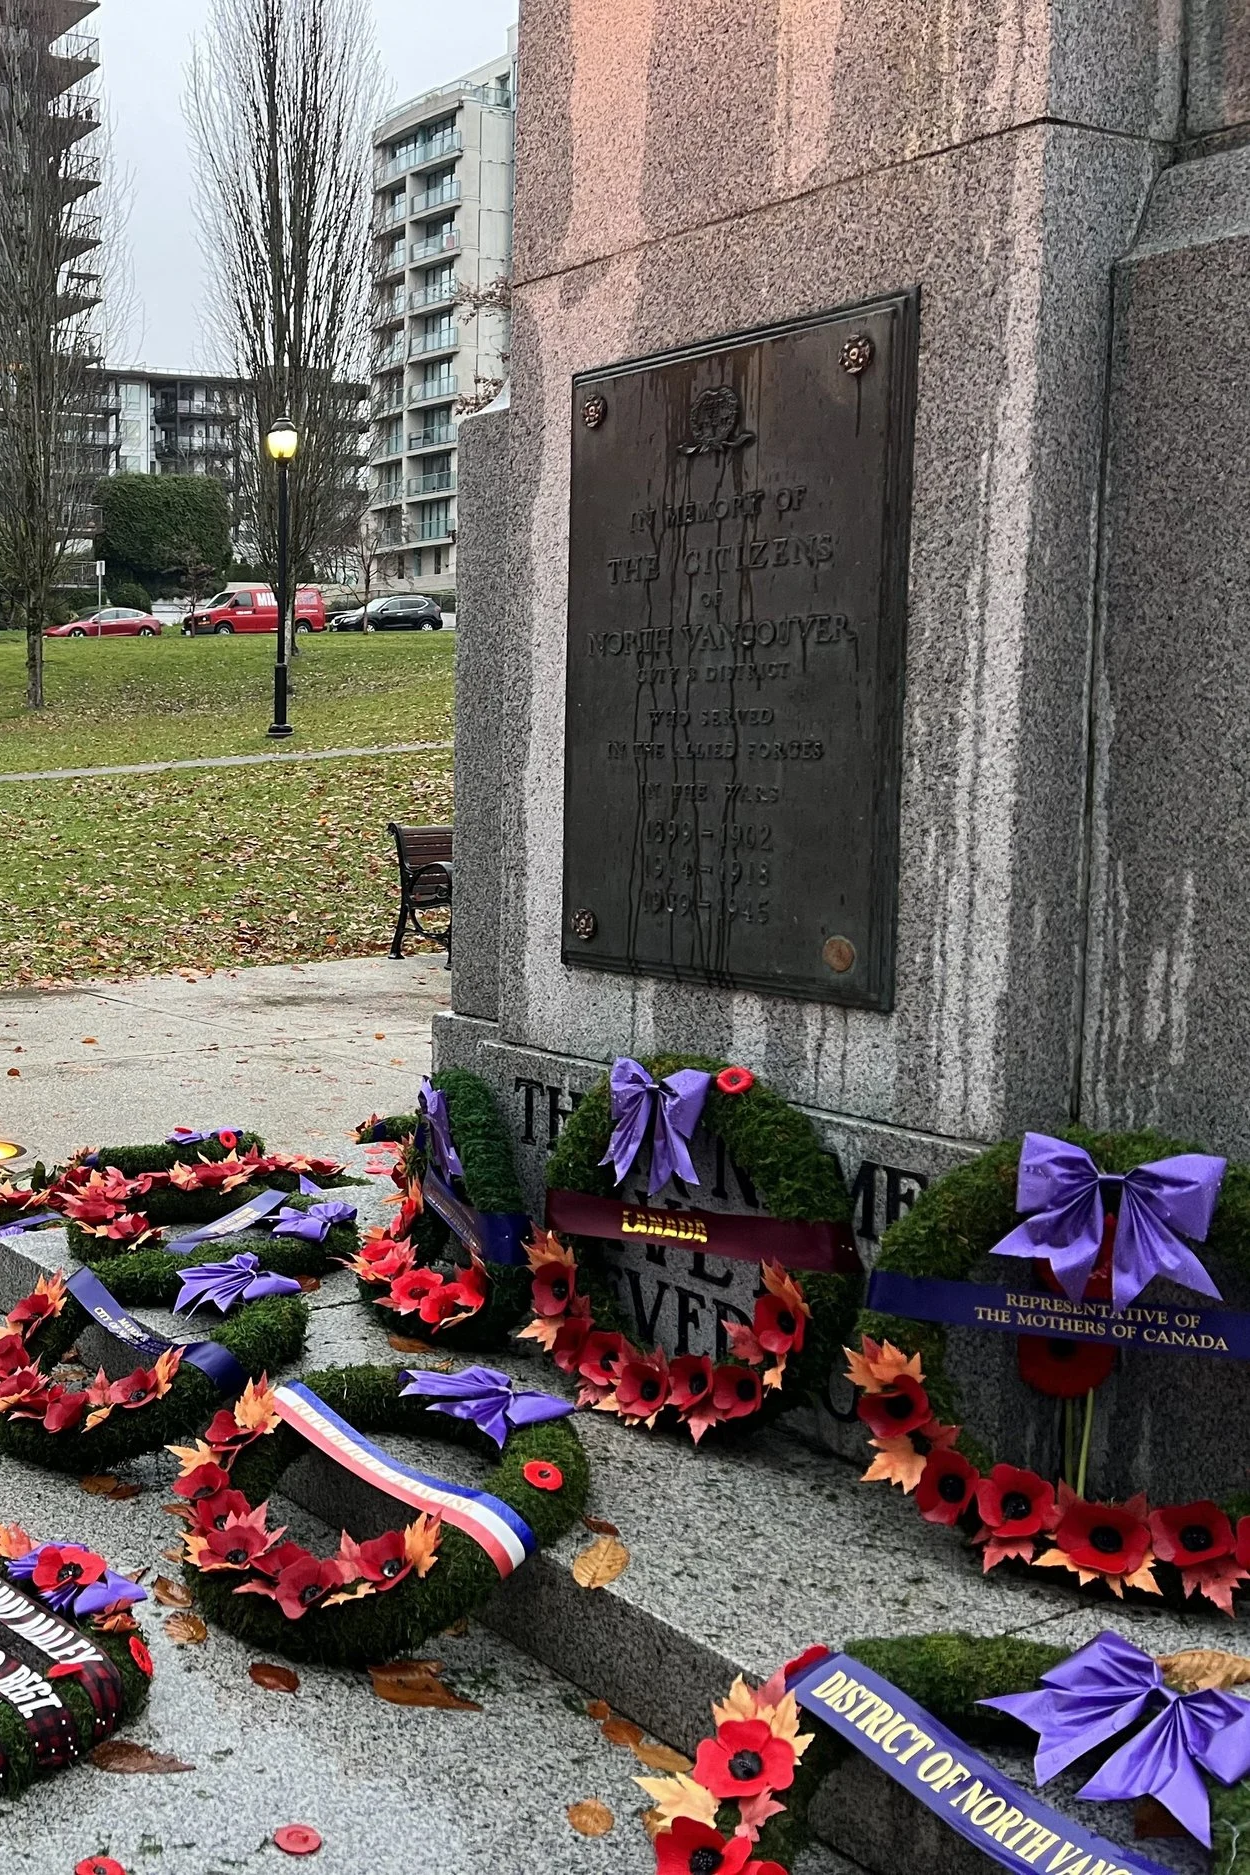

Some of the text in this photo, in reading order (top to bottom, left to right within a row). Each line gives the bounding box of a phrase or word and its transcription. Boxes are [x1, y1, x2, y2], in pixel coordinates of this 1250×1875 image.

[630, 487, 807, 534] IN MEMORY OF
[607, 533, 834, 585] THE CITIZENS
[700, 590, 724, 608] OF
[587, 614, 857, 657] NORTH VANCOUVER
[704, 661, 791, 683] DISTRICT
[649, 707, 775, 727] WHO SERVED
[634, 741, 665, 760] THE
[672, 740, 737, 760] ALLIED
[747, 740, 825, 761] FORCES
[621, 1208, 708, 1243] CANADA
[974, 1306, 1230, 1352] THE MOTHERS OF CANADA
[1005, 1292, 1201, 1330] REPRESENTATIVE OF
[7, 1612, 104, 1665] MALEY
[809, 1669, 1133, 1875] DISTRICT OF NORTH VAN
